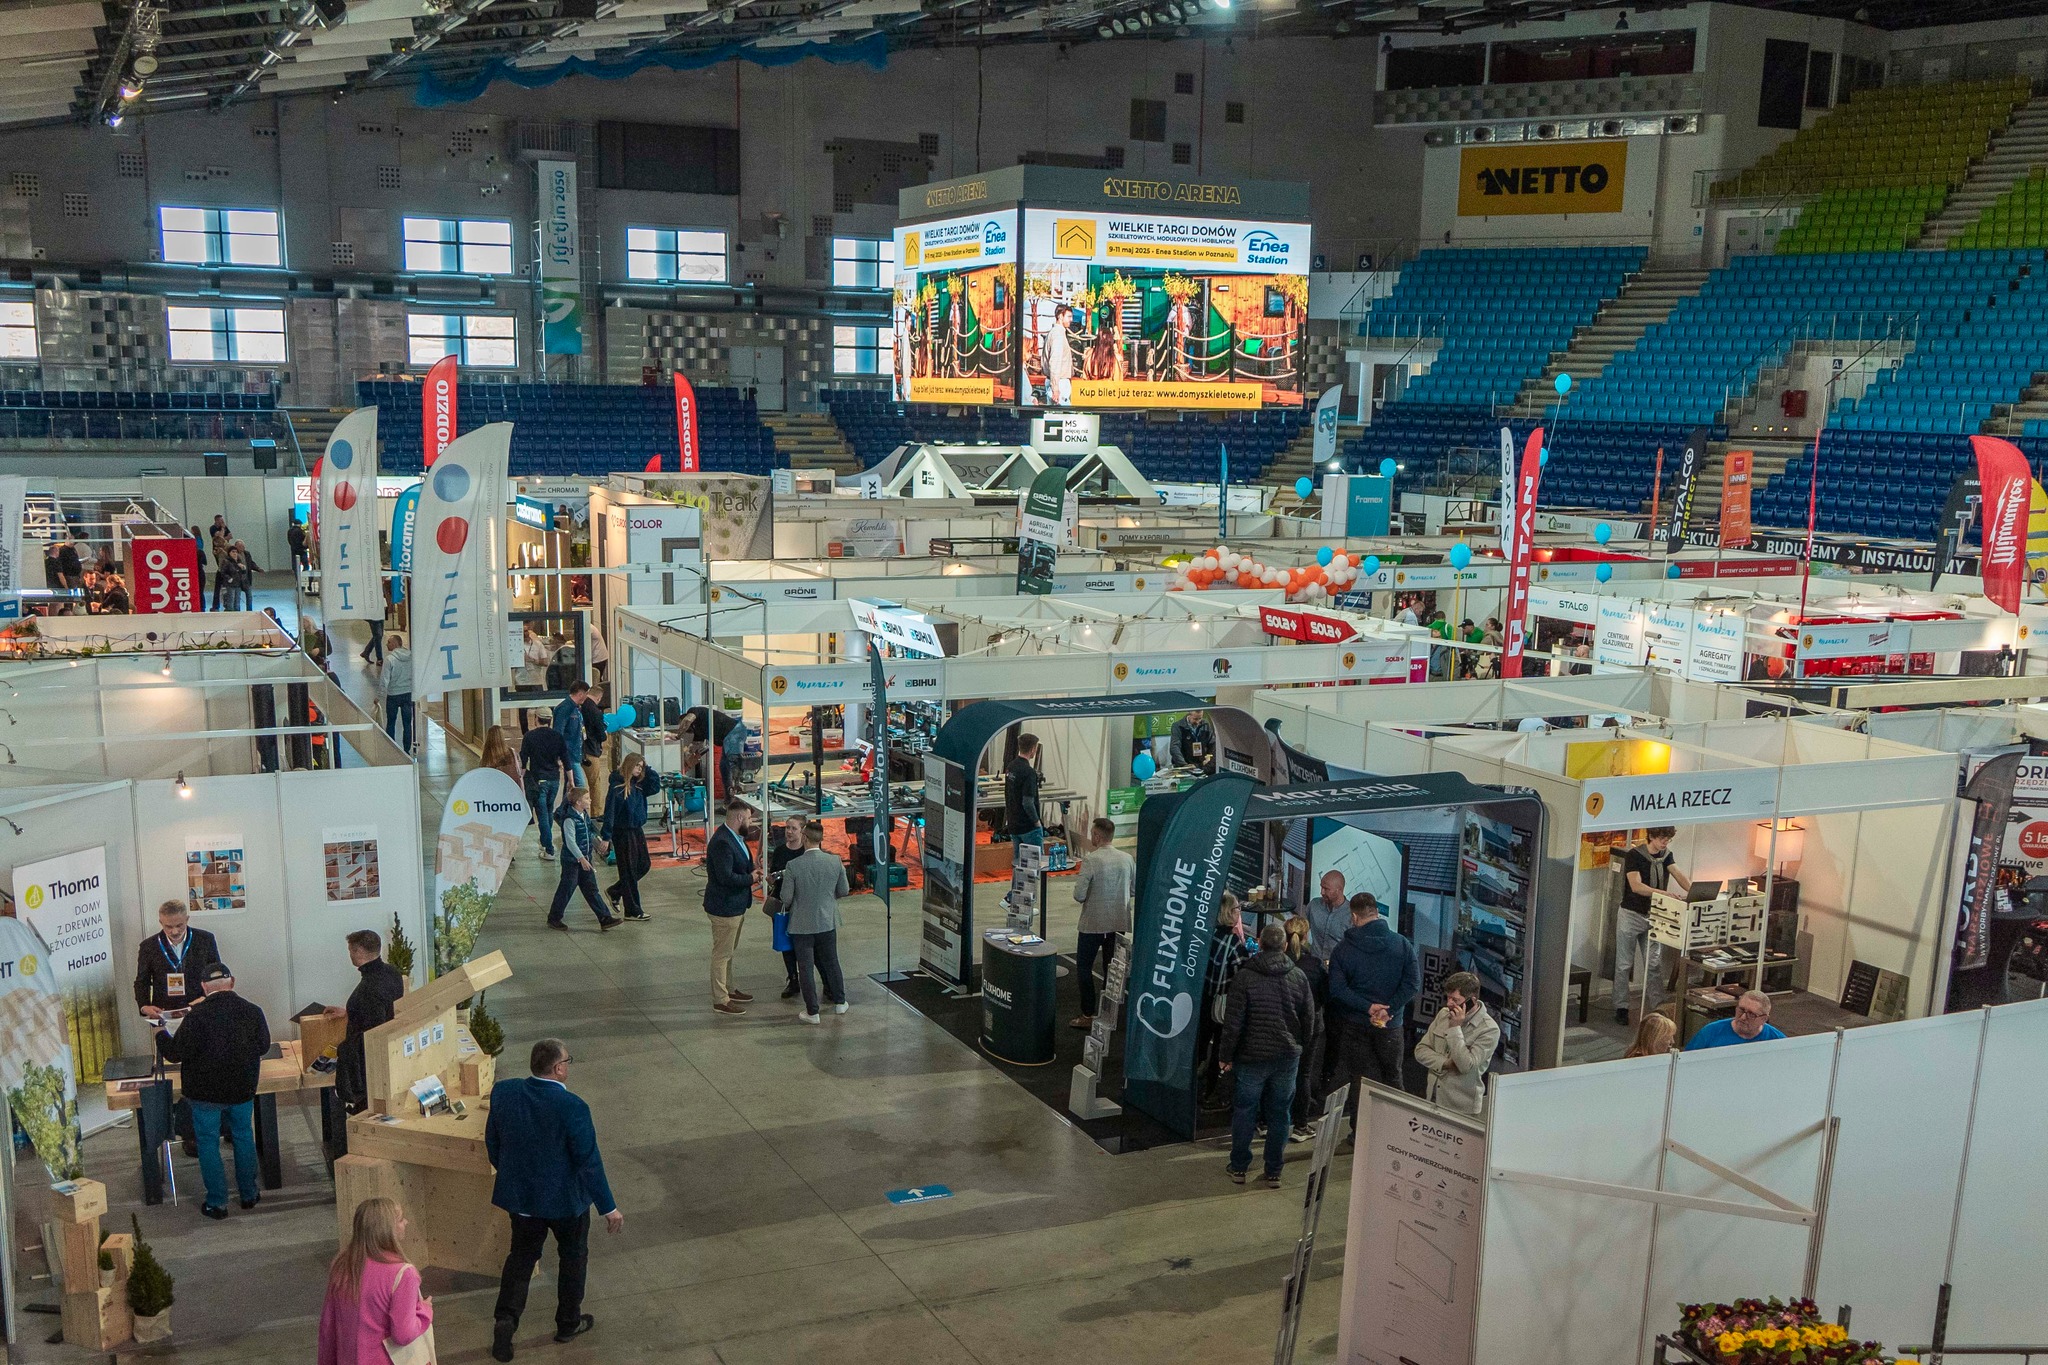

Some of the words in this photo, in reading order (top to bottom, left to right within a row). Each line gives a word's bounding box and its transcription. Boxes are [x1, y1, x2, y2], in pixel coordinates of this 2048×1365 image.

[555, 171, 565, 202] 2050
[1483, 164, 1609, 195] NETTO
[956, 181, 987, 202] ARENA
[1105, 178, 1172, 200] NETTO
[1174, 183, 1241, 205] ARENA
[924, 226, 944, 239] WIELKIE
[944, 224, 959, 236] TARGI
[985, 229, 1007, 244] Enea
[1108, 221, 1154, 234] WIELKIE
[1157, 224, 1189, 235] TARGI
[1191, 224, 1238, 238] DOMÓW
[985, 245, 1006, 256] Stadion
[1121, 247, 1134, 255] maj
[1135, 247, 1151, 255] 2025
[1155, 247, 1172, 255] Enea
[1172, 248, 1197, 257] Stadion
[1205, 250, 1235, 259] Poznaniu
[1249, 238, 1290, 254] Enea
[1247, 254, 1288, 265] Stadion
[1079, 388, 1097, 400] Kup
[1098, 388, 1117, 398] bilet
[1118, 388, 1131, 400] już
[1132, 389, 1155, 399] teraz:
[1156, 389, 1257, 401] www.domyszkieletowe.pl
[1065, 420, 1078, 428] MS
[682, 397, 693, 469] BODZIO
[1064, 435, 1089, 443] OKNA
[1032, 492, 1058, 504] GRÖNE
[1680, 475, 1697, 539] PERFECT
[1029, 520, 1054, 531] AGREGATY
[1028, 528, 1054, 539] MALARSKIE
[1513, 476, 1534, 609] TITAN
[484, 583, 492, 597] dla
[784, 587, 817, 596] GRÖNE
[1085, 580, 1115, 588] GRÖNE
[485, 600, 495, 650] instalacyjna
[2019, 628, 2028, 636] 15
[1602, 638, 1634, 650] GLAZURNICZE
[1607, 632, 1630, 641] CENTRUM
[1804, 637, 1812, 645] 15
[1699, 649, 1732, 661] AGREGATY
[486, 653, 496, 675] firma
[1117, 667, 1126, 676] 13
[774, 679, 785, 690] 12
[912, 678, 937, 687] BIHUI
[1252, 782, 1421, 802] Marzenia
[474, 799, 522, 815] Thoma
[1591, 797, 1600, 811] 7
[1630, 791, 1678, 812] MAŁA
[1681, 788, 1732, 807] RZECZ
[2024, 832, 2034, 843] 5
[49, 875, 100, 900] Thoma
[1180, 935, 1206, 978] domy
[1195, 804, 1235, 933] prefabrykowane
[74, 900, 101, 916] DOMY
[57, 925, 63, 936] Z
[65, 914, 103, 933] DREWNA
[67, 951, 107, 972] Holz100
[1422, 1124, 1464, 1146] PACIFIC
[1386, 1144, 1409, 1157] CECHY
[1408, 1152, 1453, 1175] POWIERZCHNI
[1453, 1169, 1480, 1185] PACIFIC
